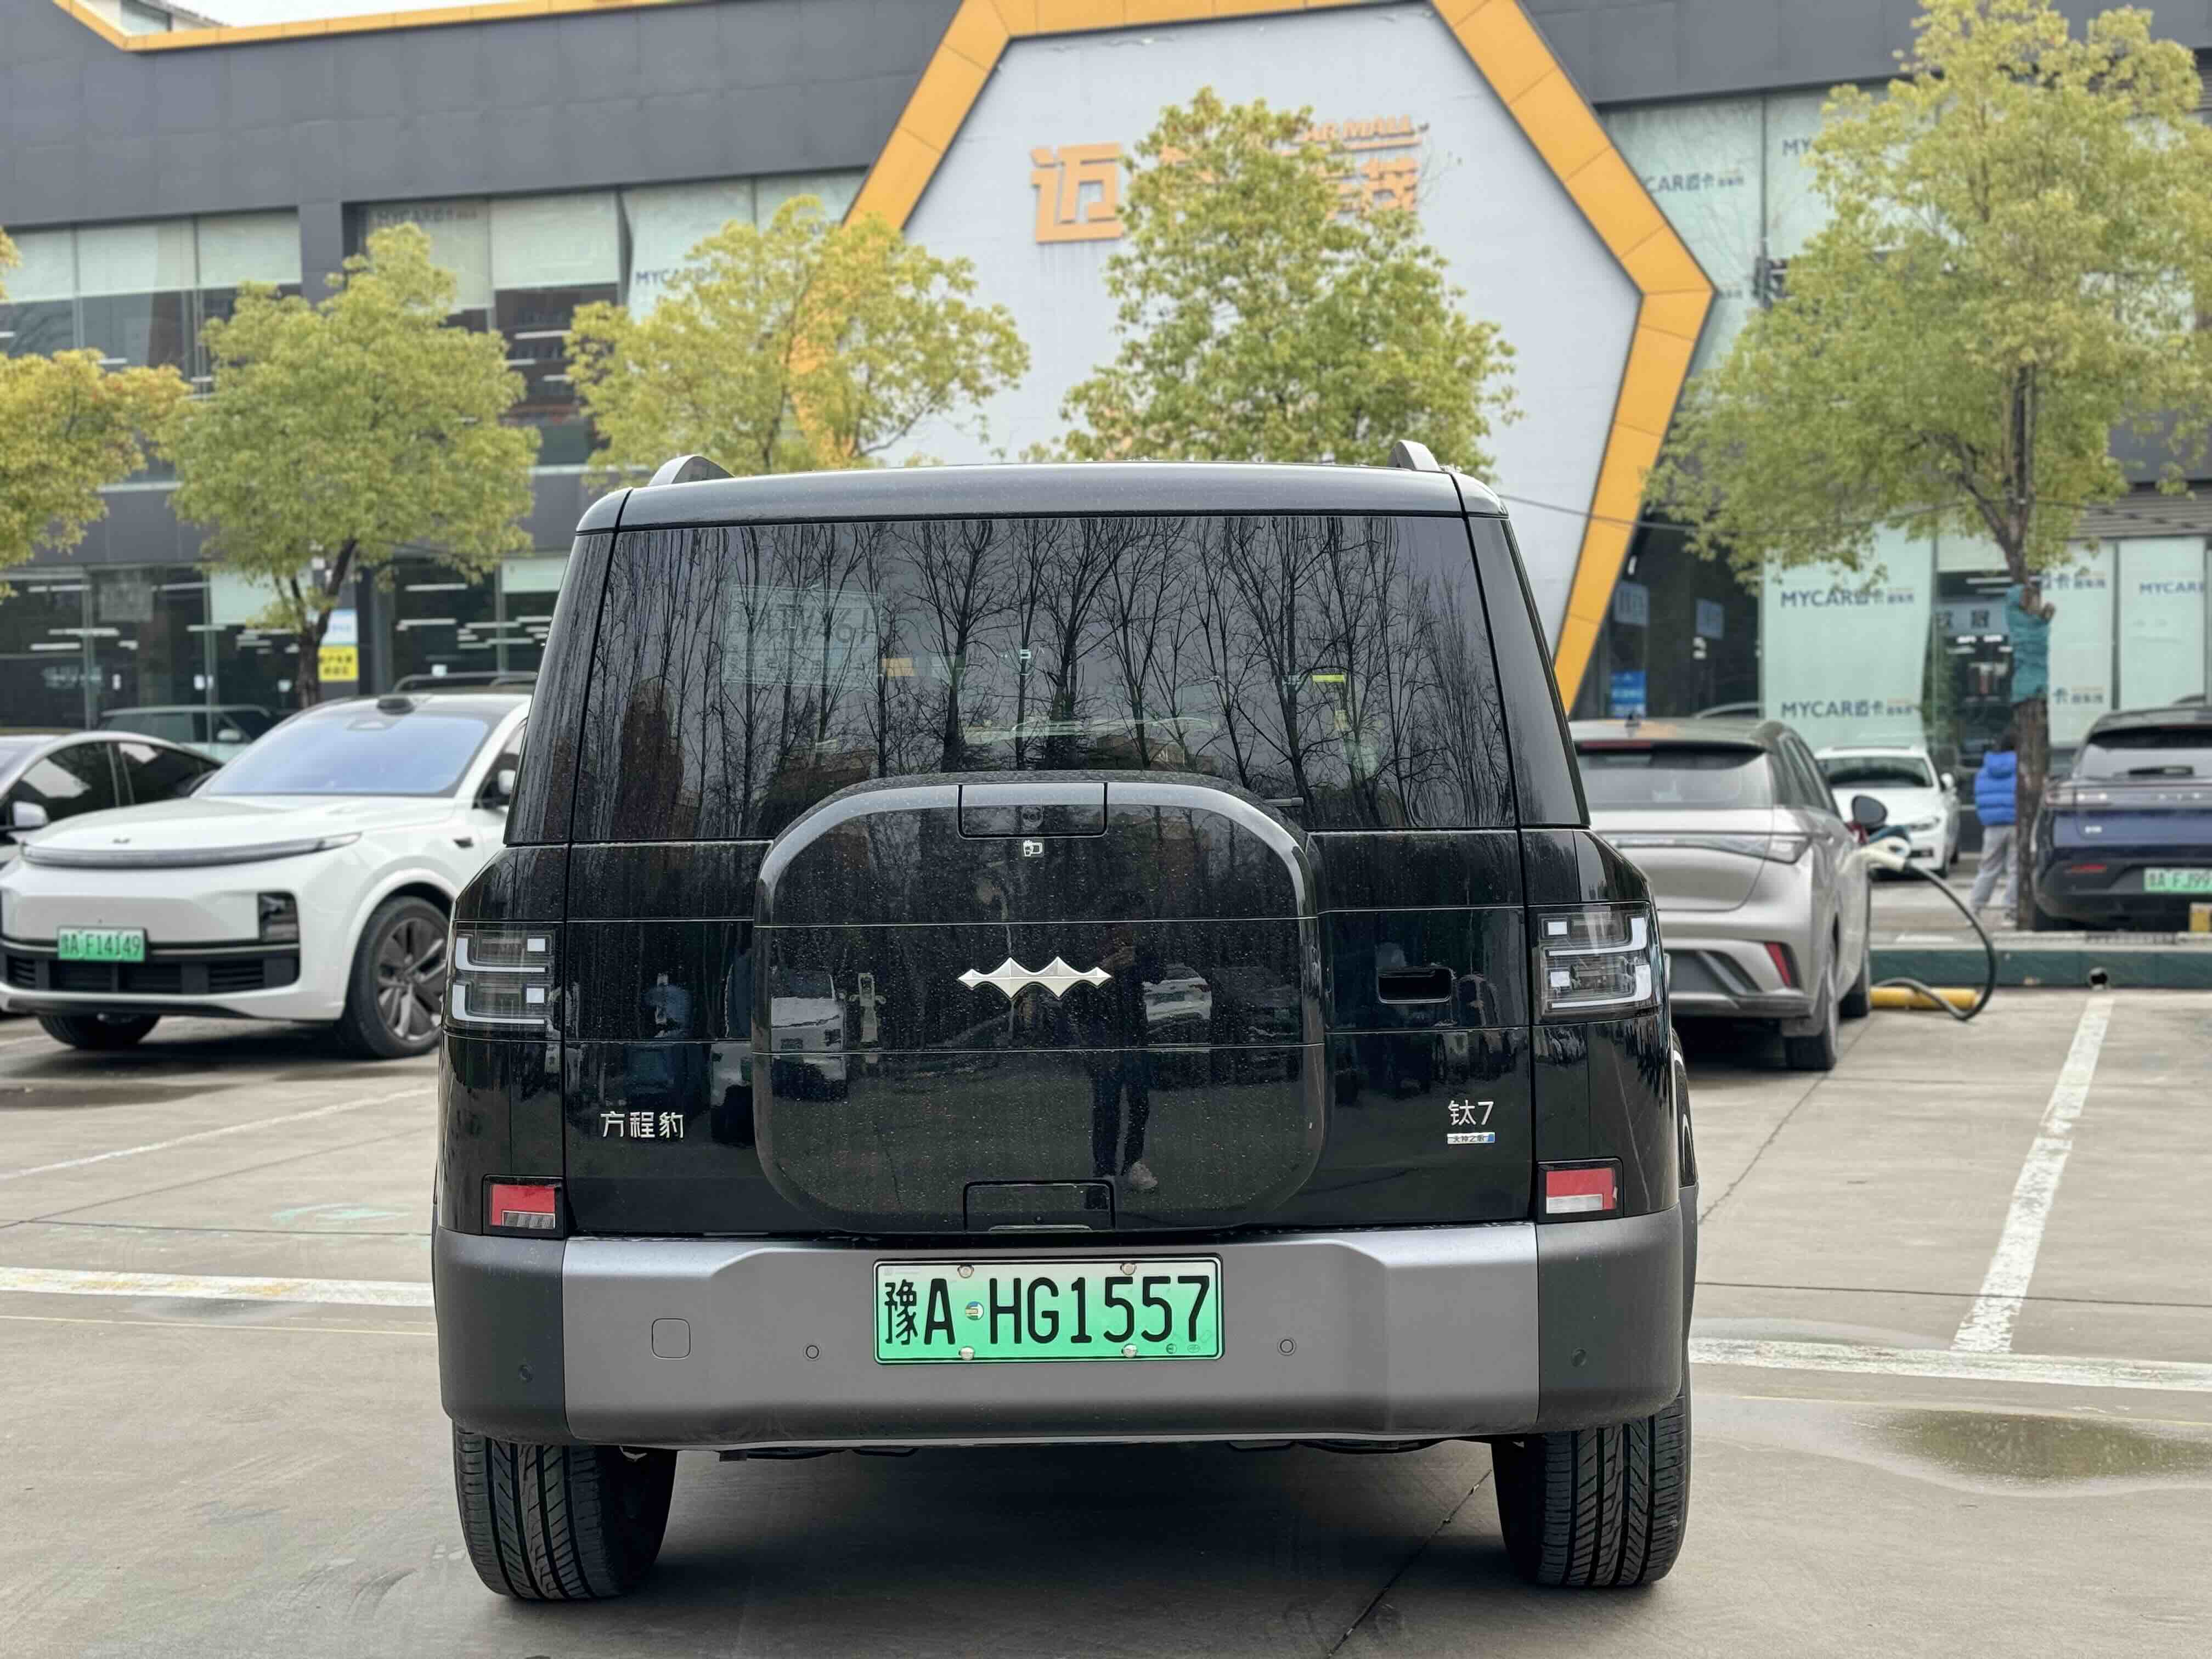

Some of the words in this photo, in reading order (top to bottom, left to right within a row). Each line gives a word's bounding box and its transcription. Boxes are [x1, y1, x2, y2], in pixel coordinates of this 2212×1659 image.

[1781, 588, 1853, 608] MYCAR
[1781, 699, 1853, 719] MYCAR
[600, 1110, 684, 1138] 方程豹
